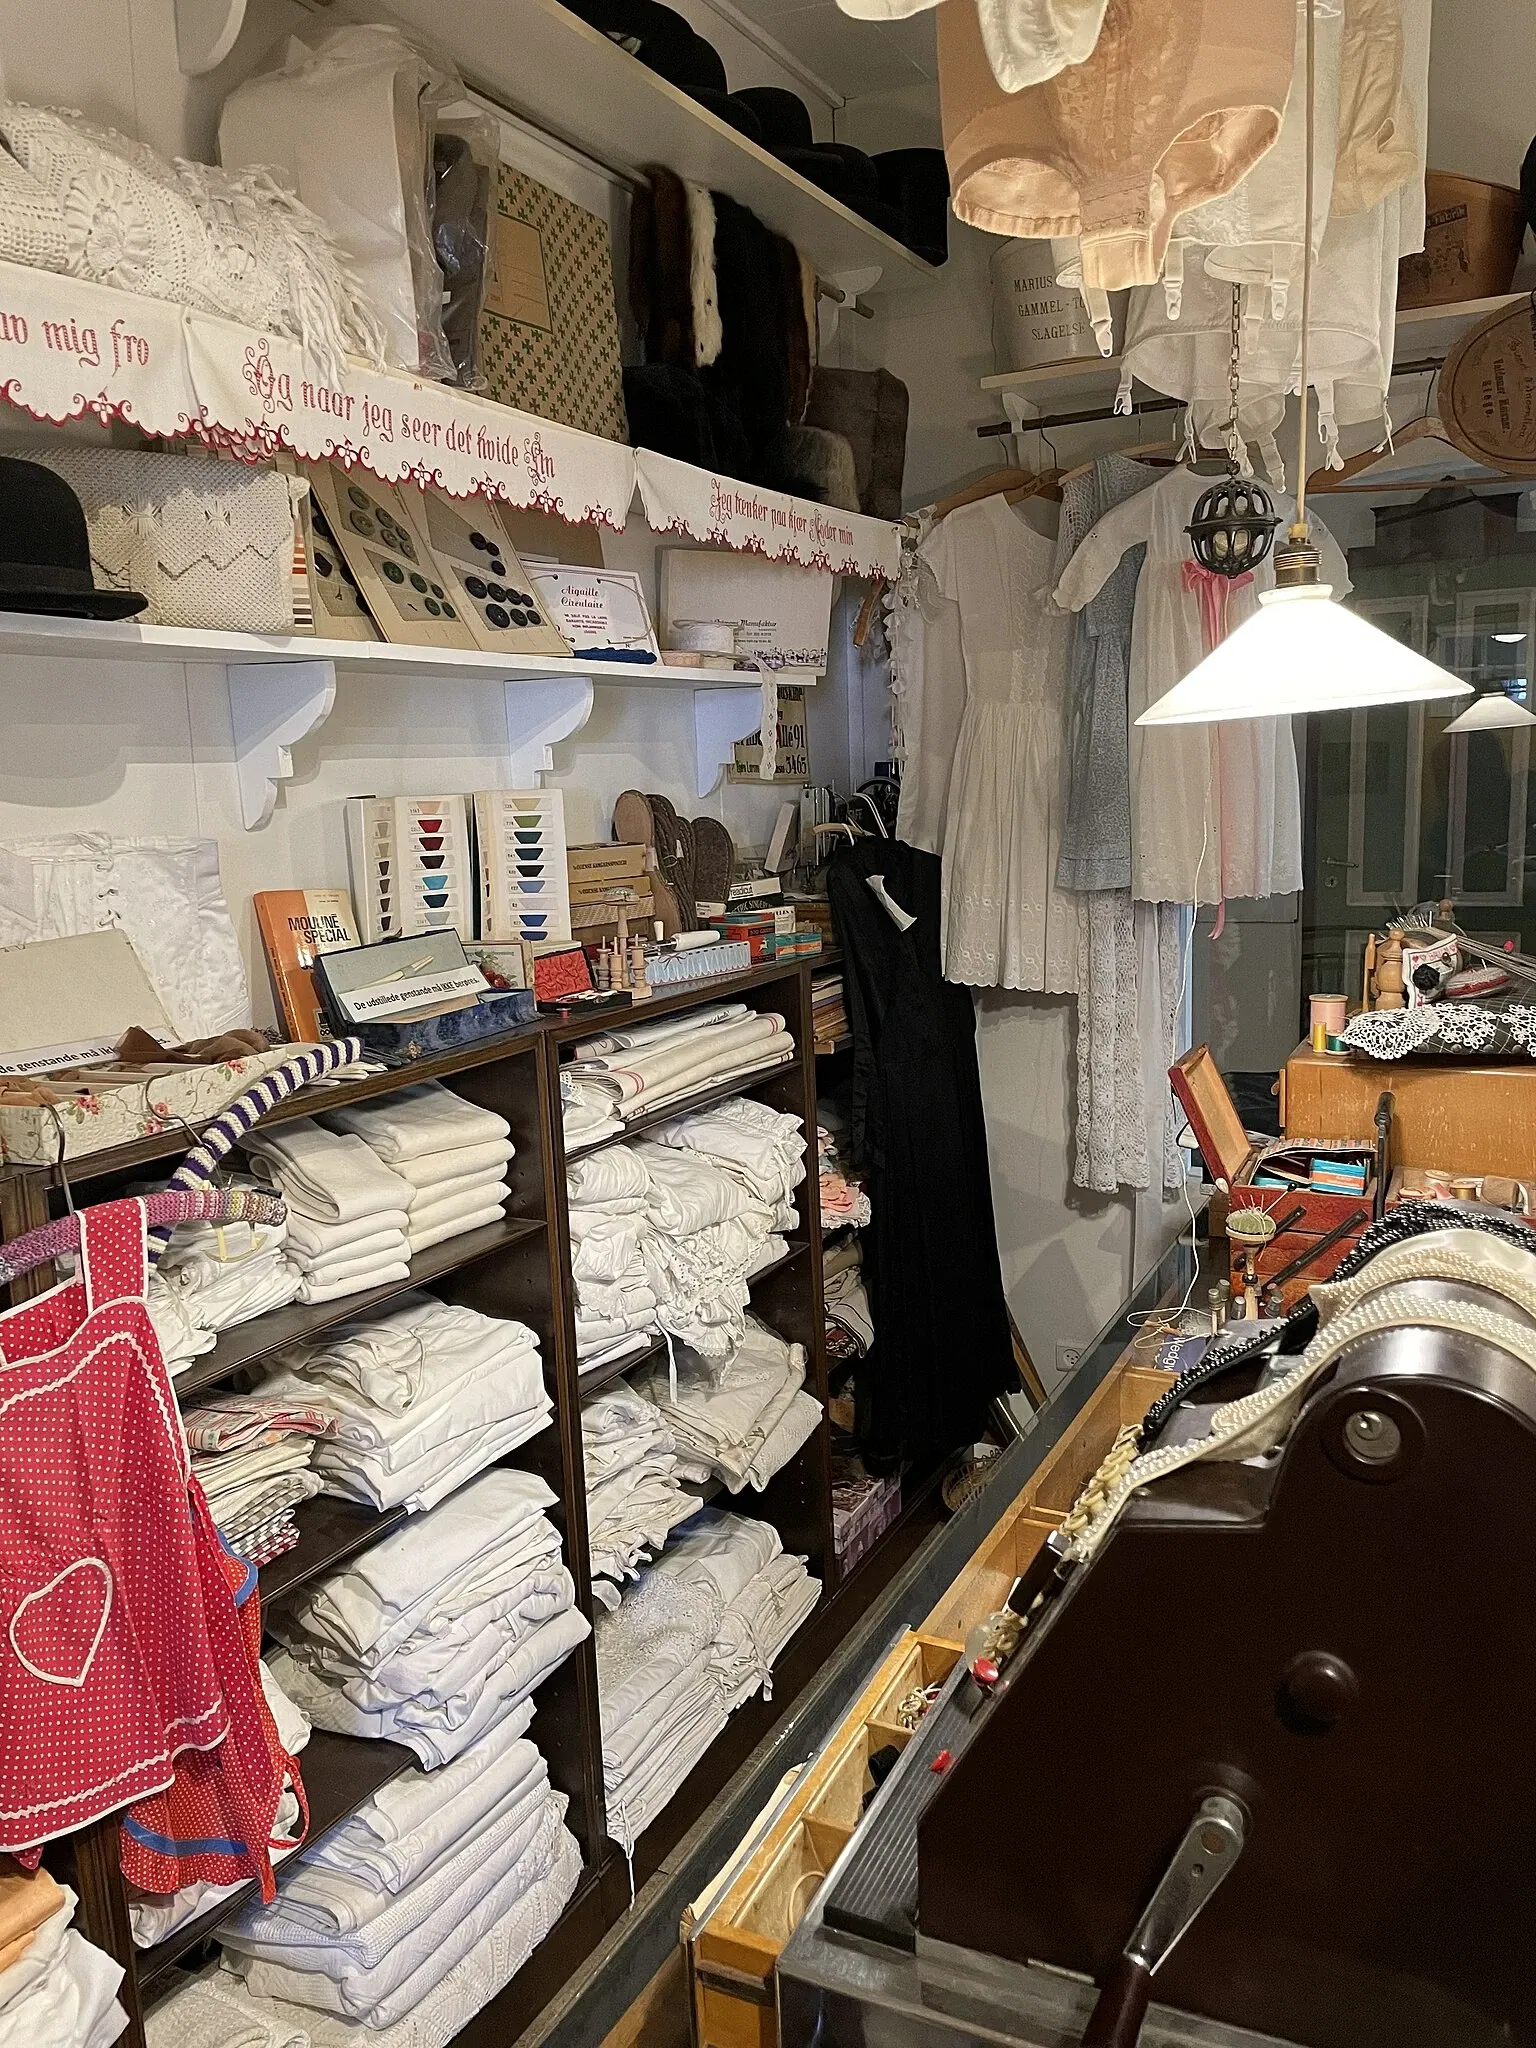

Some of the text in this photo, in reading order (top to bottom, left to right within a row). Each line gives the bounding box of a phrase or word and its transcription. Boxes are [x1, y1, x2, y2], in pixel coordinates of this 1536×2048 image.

[1014, 275, 1053, 293] MARIUS
[41, 318, 101, 368] mig
[109, 319, 149, 377] fro
[301, 381, 355, 421] naar
[362, 394, 394, 443] jeg
[401, 413, 442, 447] seer
[445, 419, 472, 455] det
[477, 424, 519, 467] hvide
[709, 477, 733, 525] Jeg
[734, 489, 769, 523] tænker
[770, 508, 787, 532] paa
[838, 525, 855, 546] min
[561, 585, 599, 597] Aiguille
[561, 596, 604, 609] Circulaire
[731, 886, 753, 897] readicut
[303, 928, 352, 944] SPECIAL
[353, 1001, 366, 1011] De
[366, 993, 400, 1007] udstillede
[400, 986, 433, 1001] genstande
[431, 983, 442, 993] må
[441, 980, 456, 992] IKKE
[17, 1053, 80, 1072] genstande
[79, 1048, 100, 1059] må
